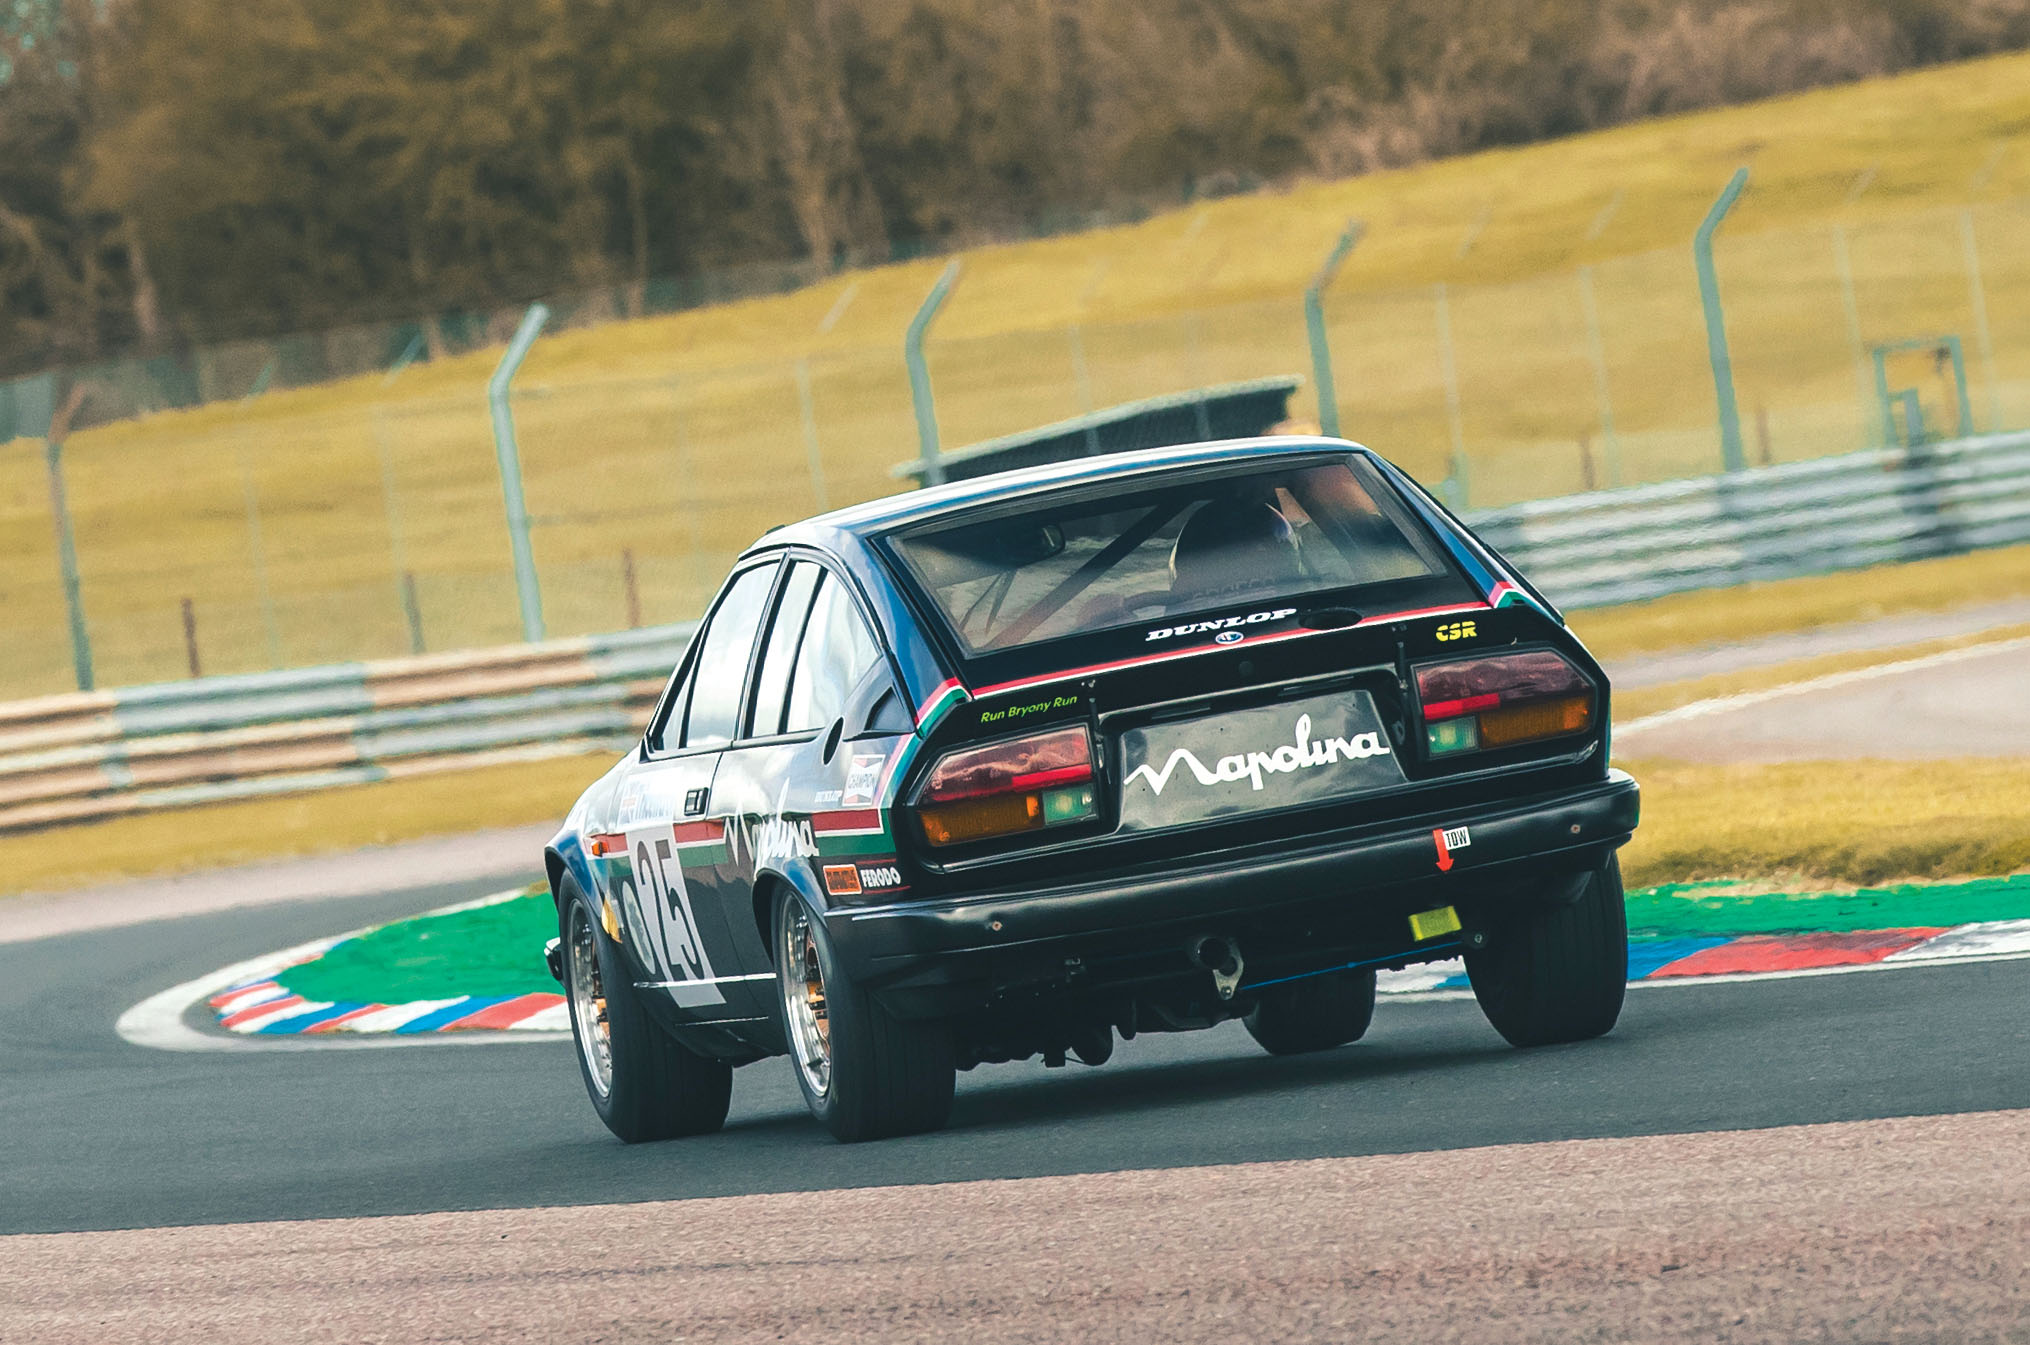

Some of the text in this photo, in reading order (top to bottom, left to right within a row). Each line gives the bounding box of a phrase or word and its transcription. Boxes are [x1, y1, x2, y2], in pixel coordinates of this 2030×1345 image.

[1145, 608, 1297, 641] DUNLOP
[1435, 620, 1478, 642] CSR
[981, 696, 1077, 723] Run Bryony Run
[1123, 713, 1390, 796] Napolina
[1445, 829, 1467, 848] TOW
[860, 867, 902, 887] FERODO
[637, 839, 705, 982] 25
